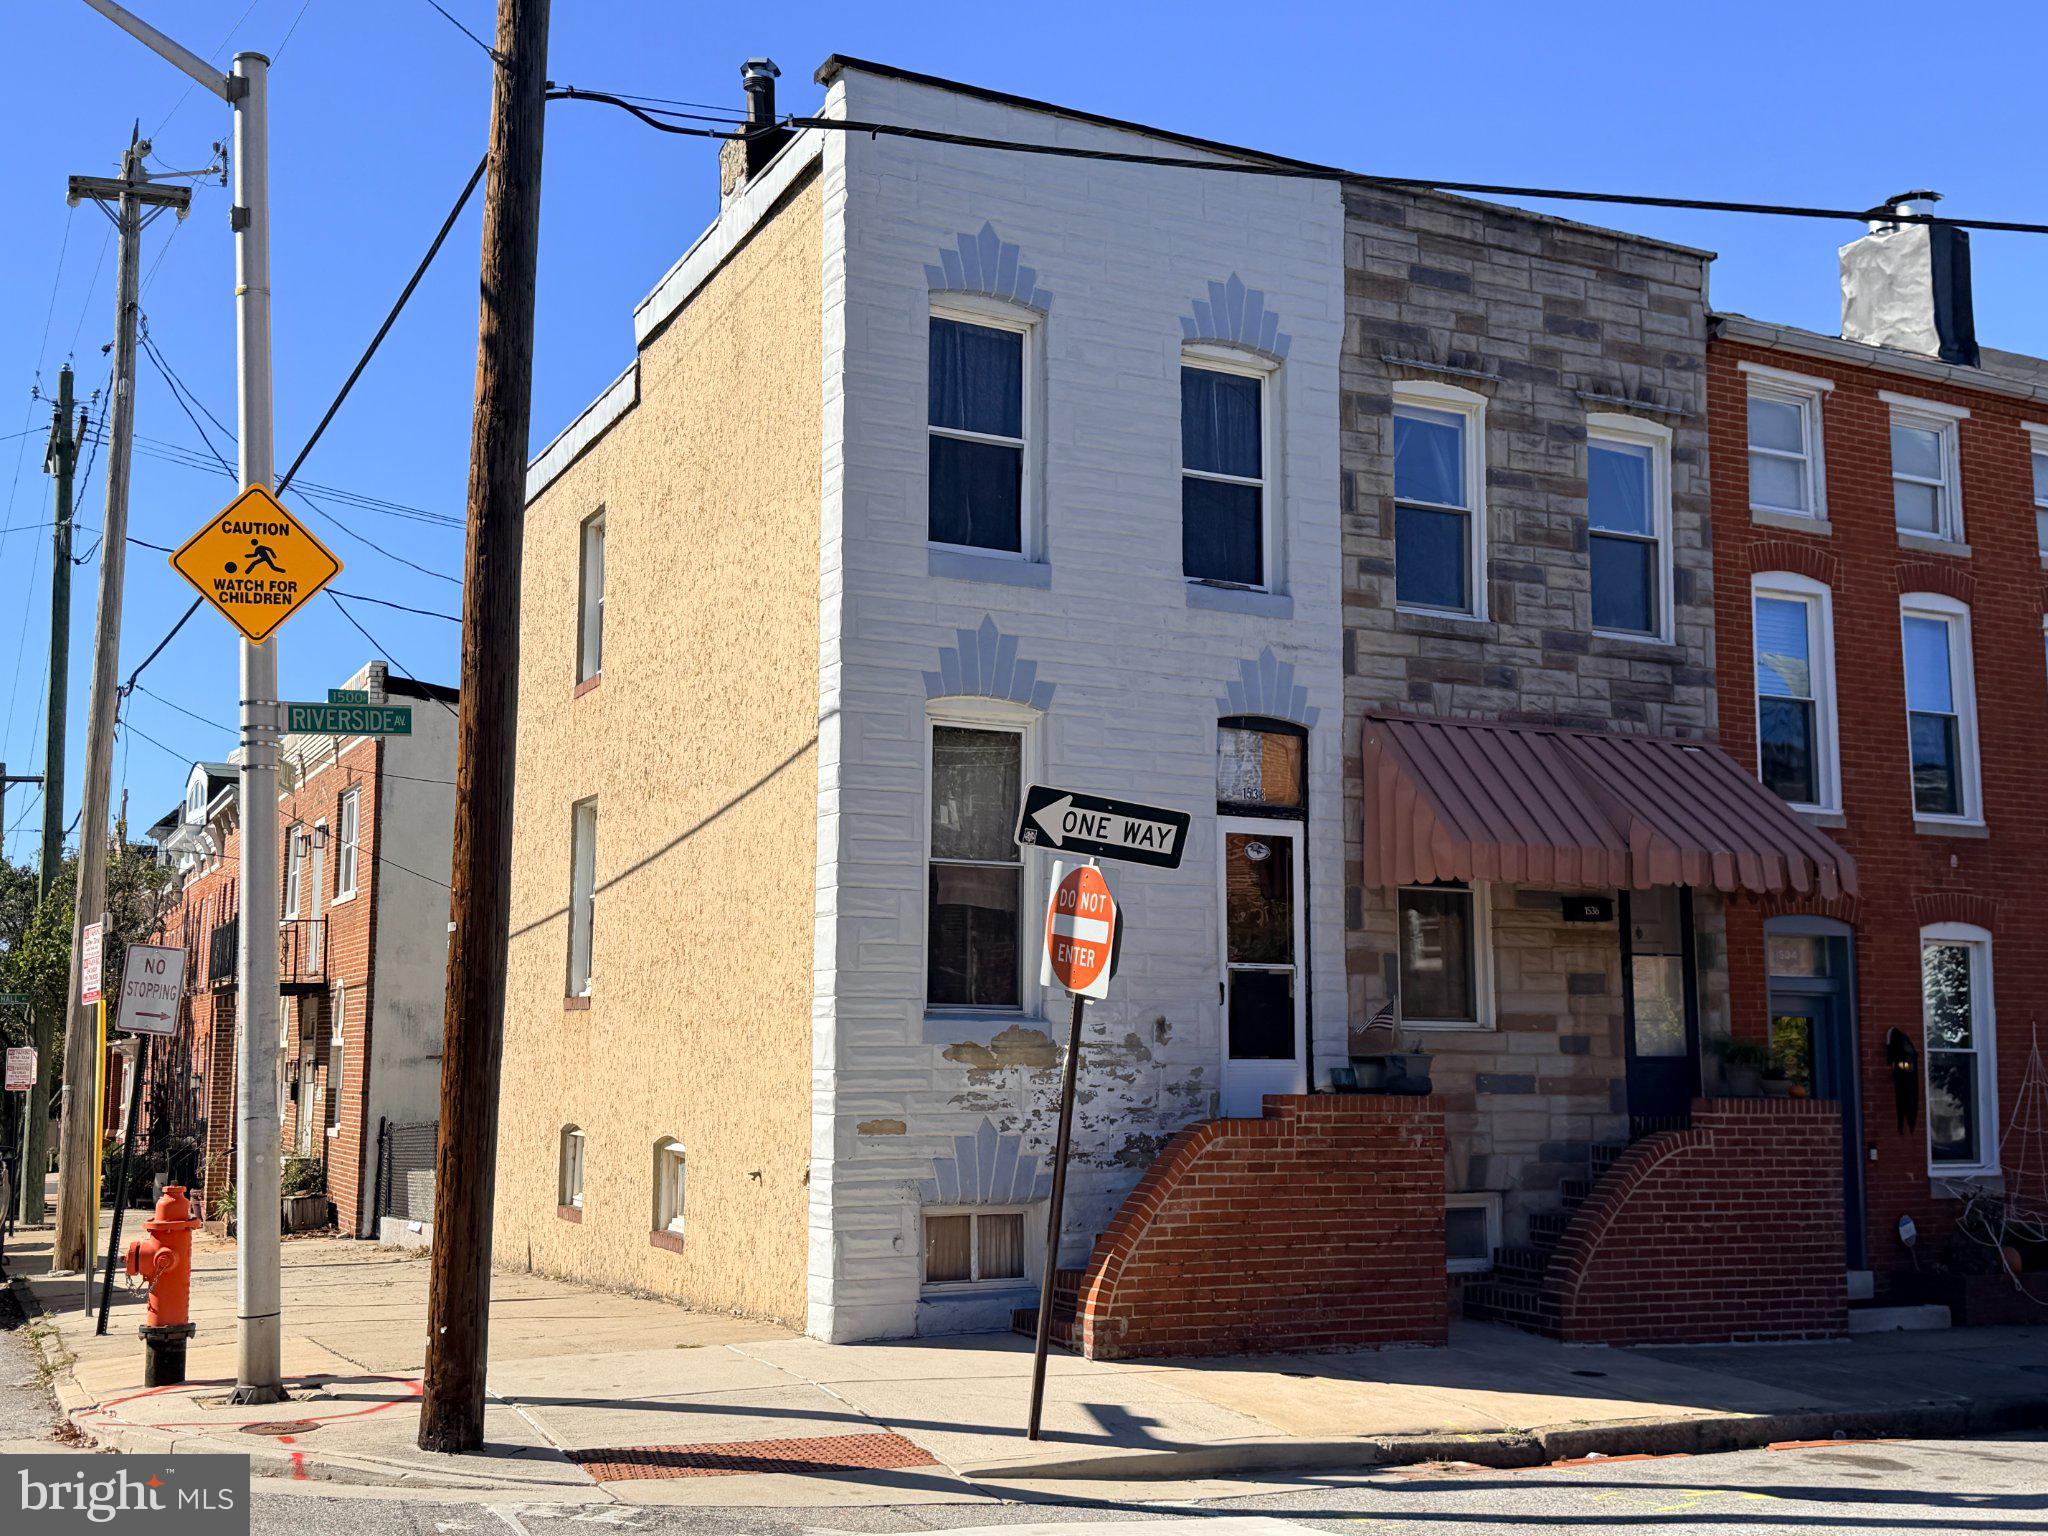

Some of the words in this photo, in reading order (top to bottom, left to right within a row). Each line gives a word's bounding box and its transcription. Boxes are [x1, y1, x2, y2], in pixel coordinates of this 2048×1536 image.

[221, 520, 290, 536] CAUTION
[213, 578, 265, 592] WATCH
[269, 580, 298, 593] FOR
[218, 591, 292, 605] CHILDREN
[333, 691, 362, 703] 1500
[292, 708, 395, 732] RIVERSIDE
[1243, 787, 1266, 801] 1538
[1062, 810, 1112, 840] ONE
[1123, 820, 1172, 849] WAY
[1060, 888, 1076, 909] DO
[1080, 891, 1107, 913] NOT
[1584, 906, 1600, 916] 1536
[1057, 943, 1095, 969] ENTER
[144, 958, 166, 975] NO
[126, 981, 177, 1002] STOPPING
